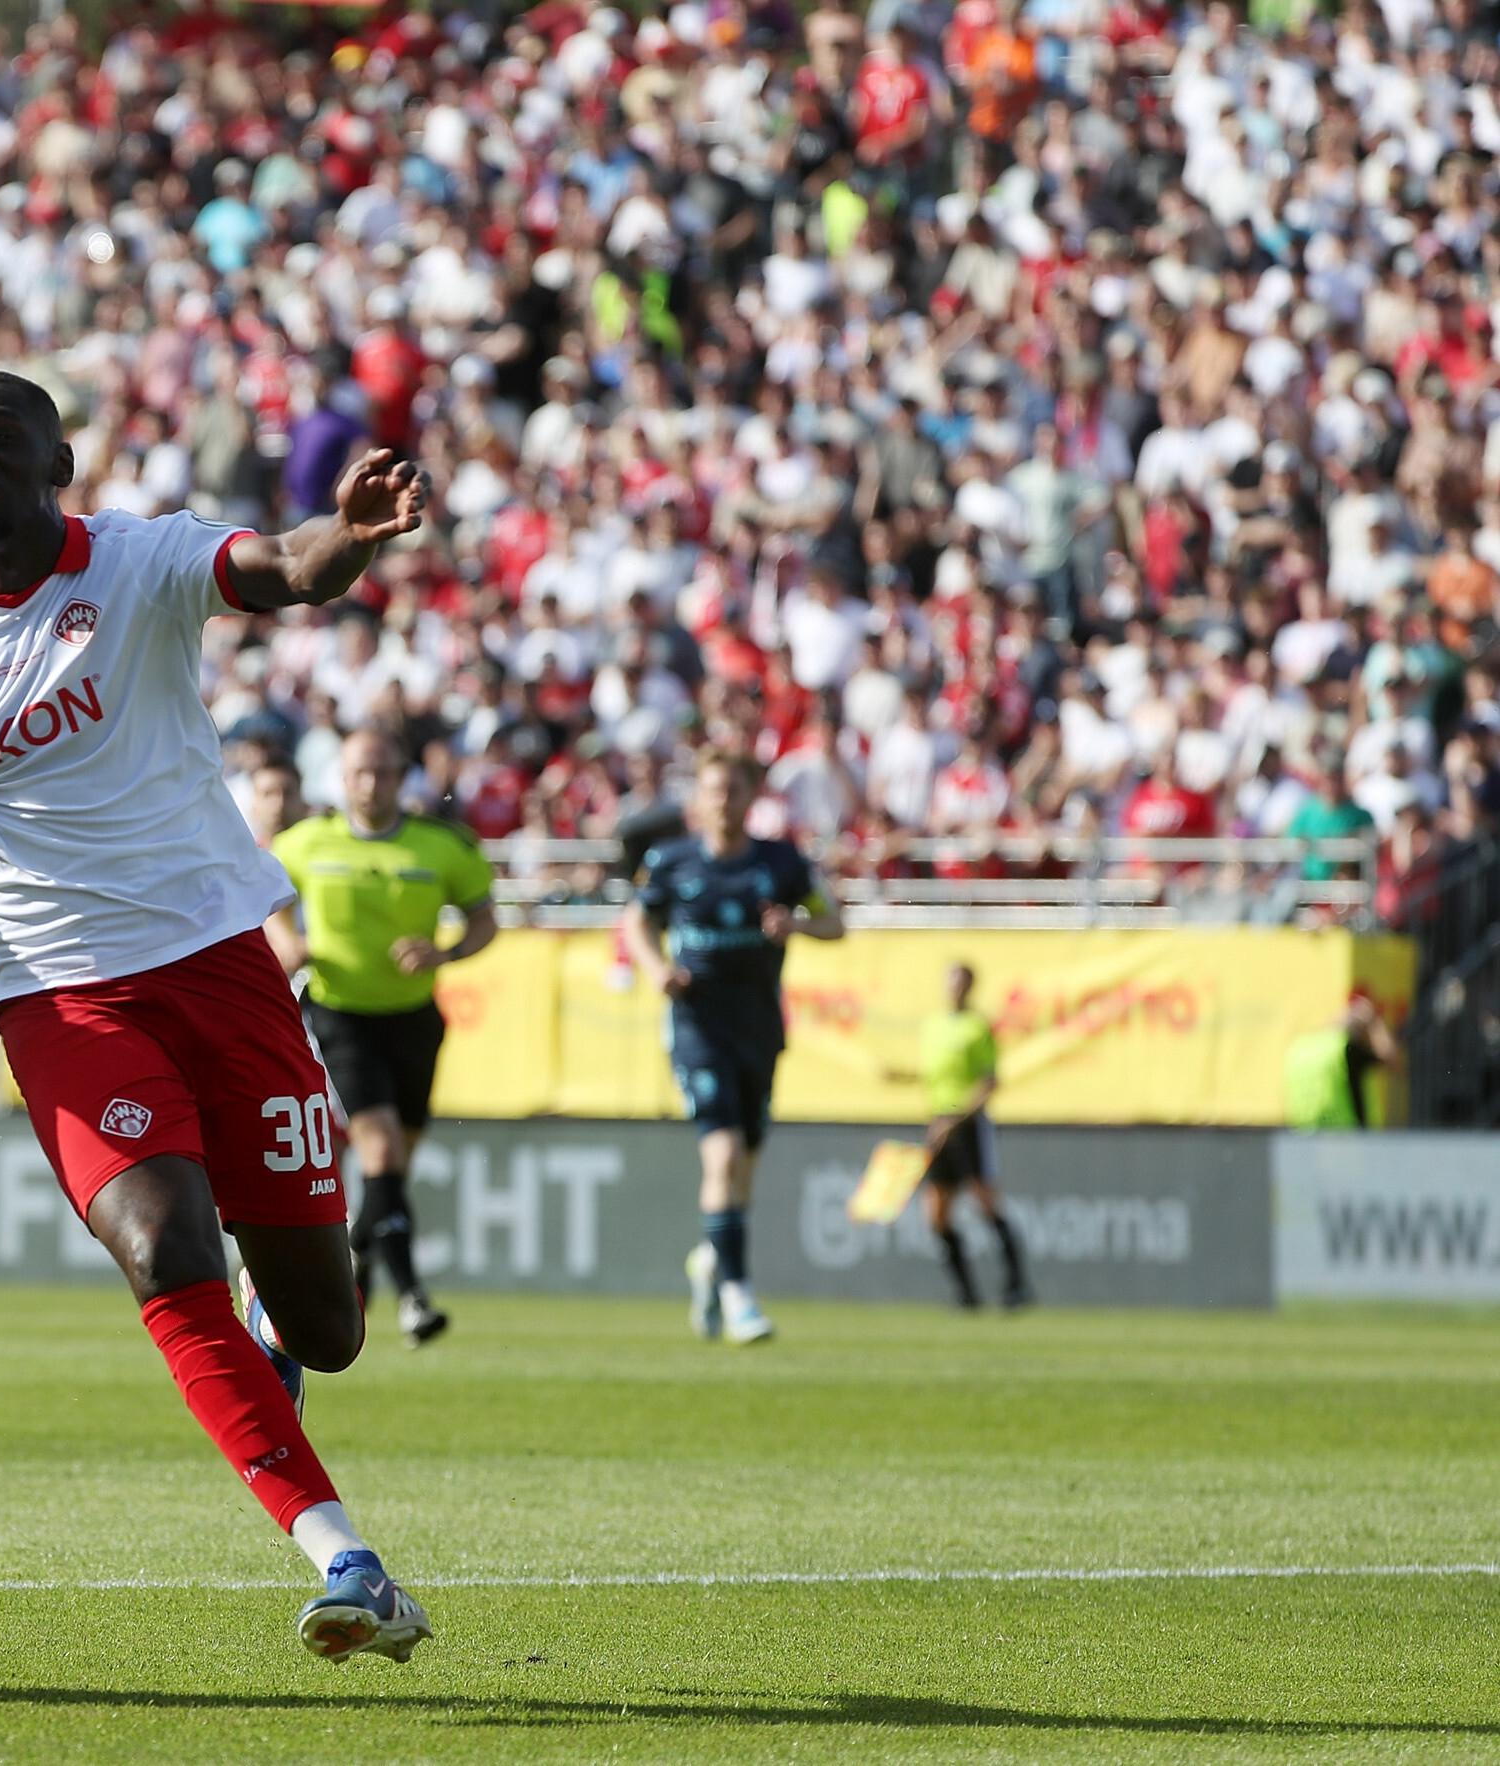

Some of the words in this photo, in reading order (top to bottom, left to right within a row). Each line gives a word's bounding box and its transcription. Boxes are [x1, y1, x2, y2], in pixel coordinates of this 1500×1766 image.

[261, 1093, 333, 1172] 30
[308, 1178, 336, 1196] JAKO
[242, 1446, 289, 1484] JAKO
